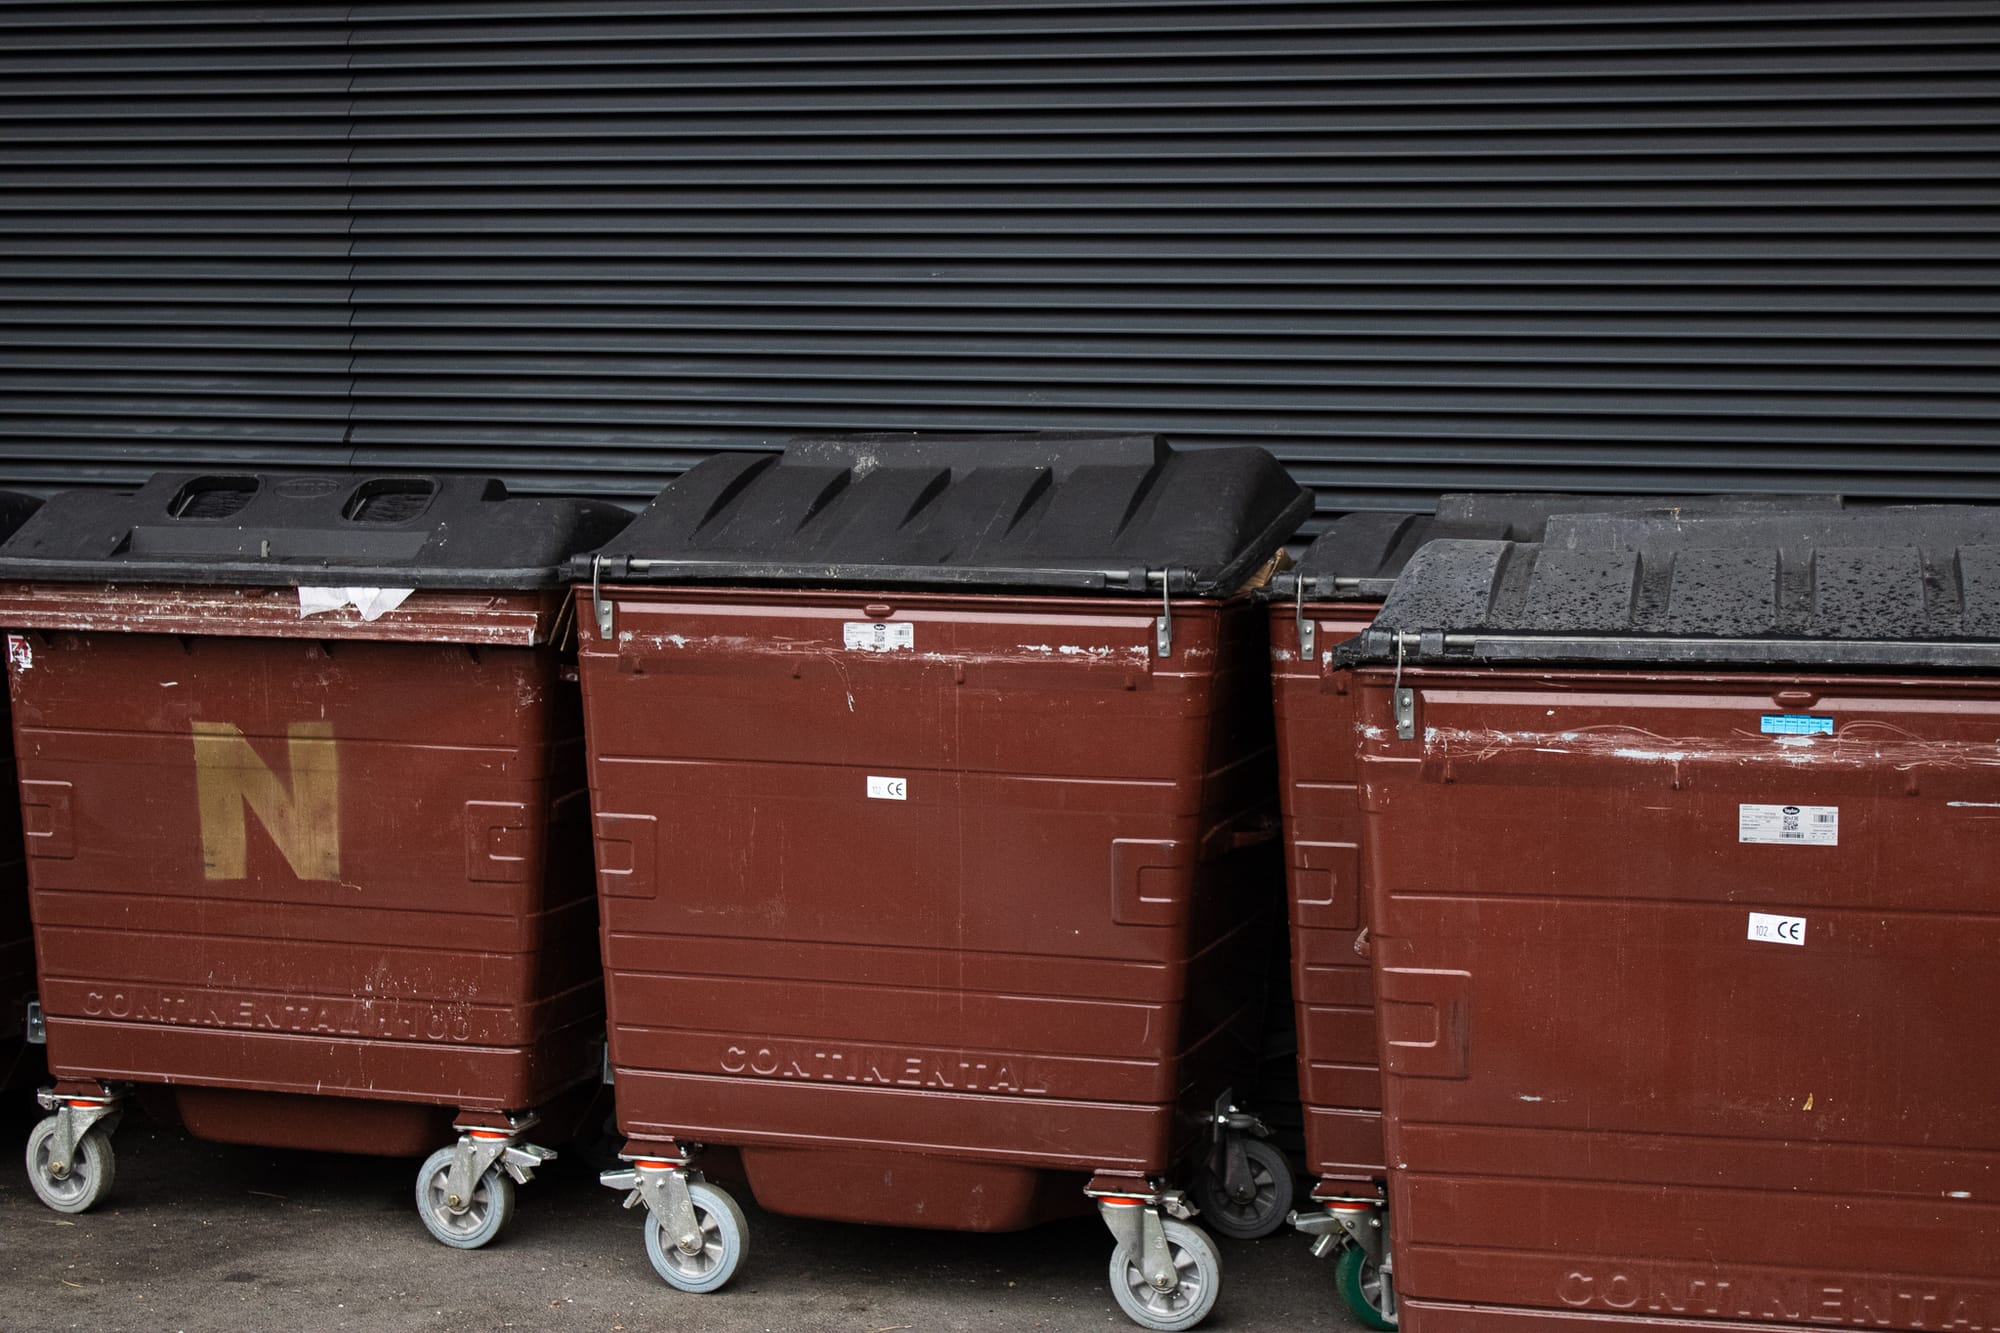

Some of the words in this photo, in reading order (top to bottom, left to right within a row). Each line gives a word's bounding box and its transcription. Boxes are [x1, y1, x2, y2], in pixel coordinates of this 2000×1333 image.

[191, 721, 341, 881] N
[887, 782, 903, 796] CE
[1756, 925, 1769, 937] 102
[1777, 921, 1800, 940] CE
[82, 990, 360, 1035] CONTINENTAL
[720, 1045, 1047, 1094] CONTINENTAL
